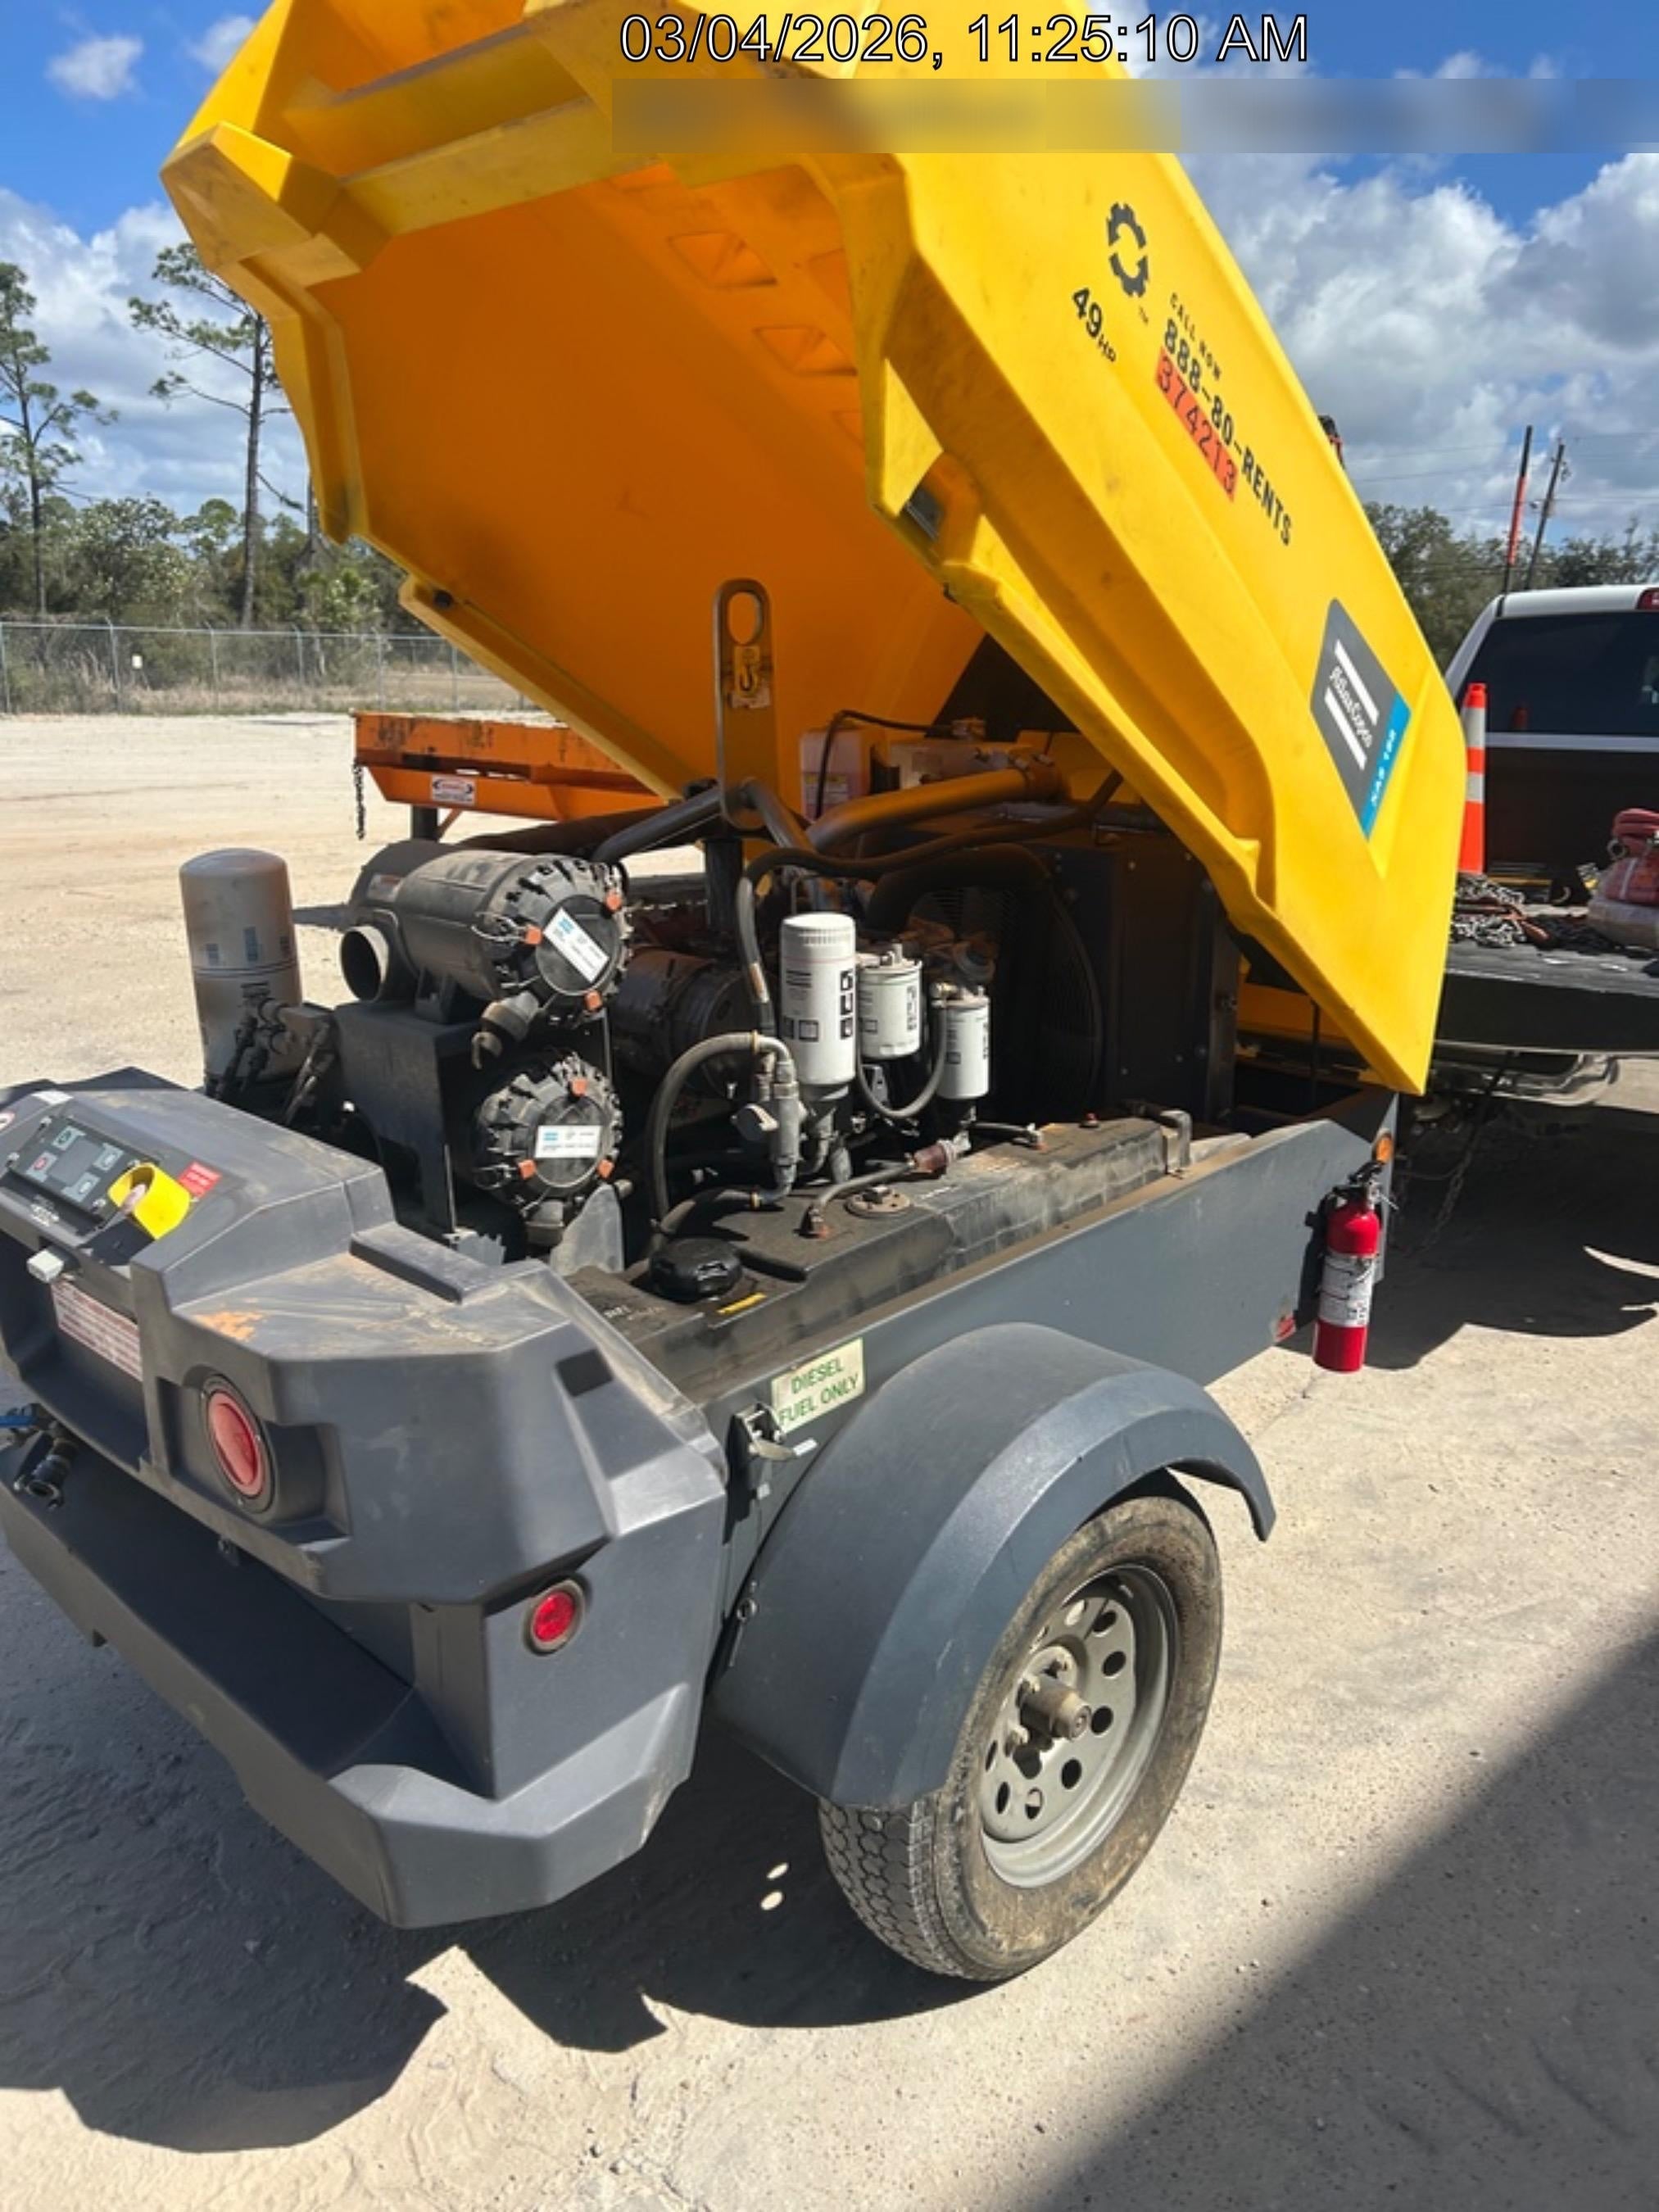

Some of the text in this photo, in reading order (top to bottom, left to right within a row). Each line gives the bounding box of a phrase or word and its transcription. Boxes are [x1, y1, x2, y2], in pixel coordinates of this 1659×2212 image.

[1164, 318, 1292, 546] 888-80-RENTS
[778, 1373, 859, 1425] FUEL ONLY
[791, 1358, 844, 1394] DIESEL
